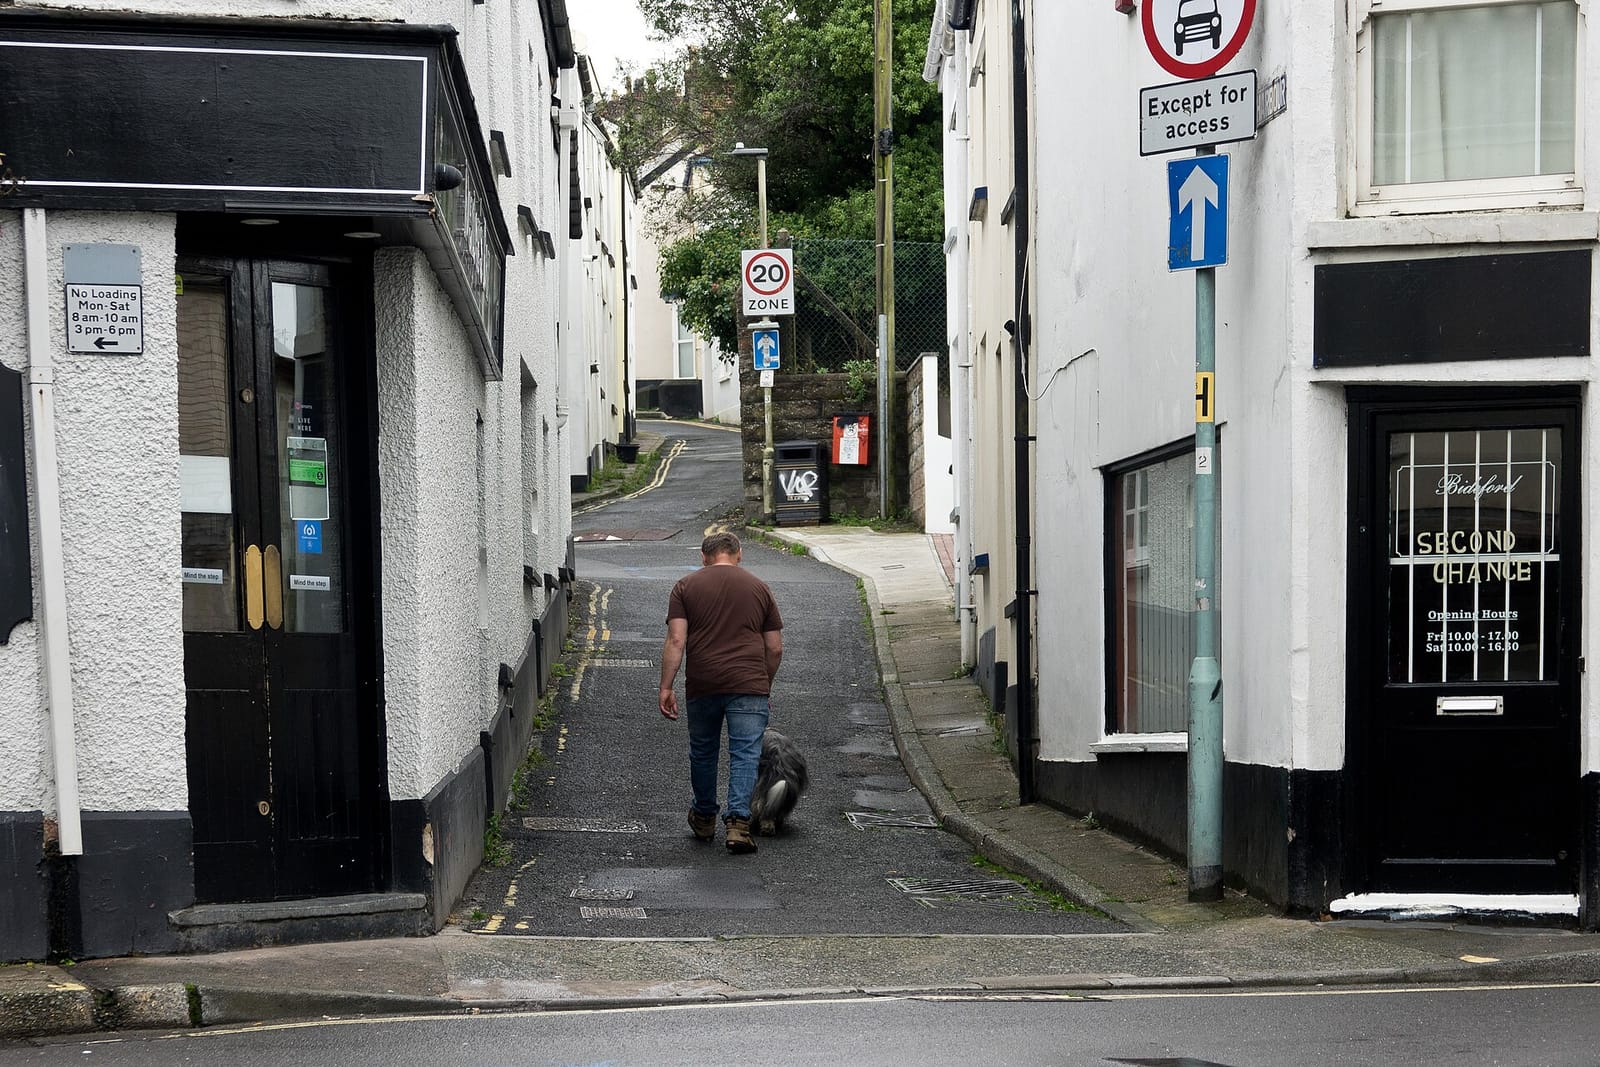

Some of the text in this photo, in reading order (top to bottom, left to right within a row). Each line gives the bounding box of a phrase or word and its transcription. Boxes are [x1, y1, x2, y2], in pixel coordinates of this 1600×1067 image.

[1148, 86, 1247, 116] Except for
[1166, 116, 1229, 139] access
[752, 264, 784, 283] 20
[71, 288, 137, 301] No Loading
[748, 298, 789, 310] ZONE
[1198, 455, 1207, 468] 2
[1417, 530, 1516, 554] SECOND
[1433, 560, 1531, 584] CHANCE
[1427, 609, 1519, 621] Opening Hours
[1426, 632, 1445, 641] Fri
[1425, 643, 1445, 652] Sat
